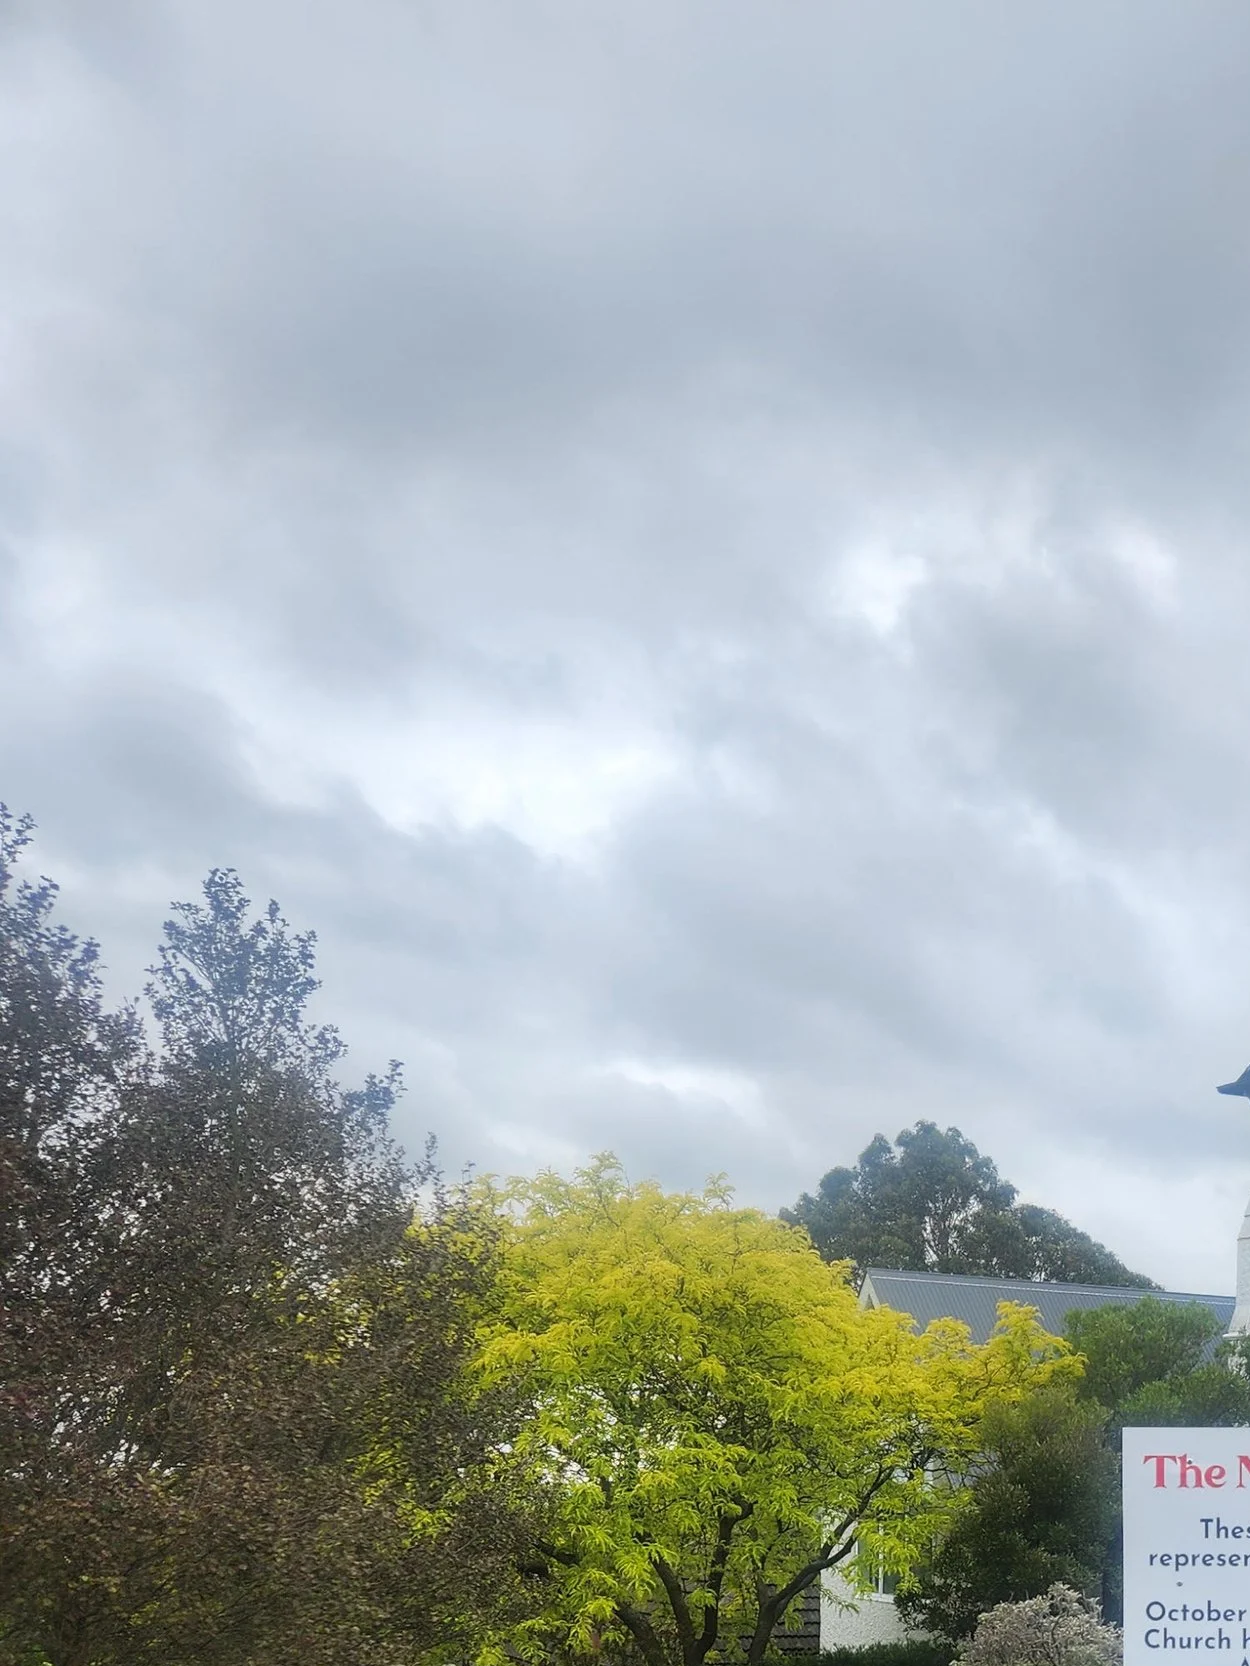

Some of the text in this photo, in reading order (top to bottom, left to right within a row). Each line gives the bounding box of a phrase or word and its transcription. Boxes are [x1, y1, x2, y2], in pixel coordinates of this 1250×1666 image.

[1143, 1454, 1225, 1488] The
[1146, 1600, 1246, 1621] October
[1145, 1628, 1230, 1649] Church
